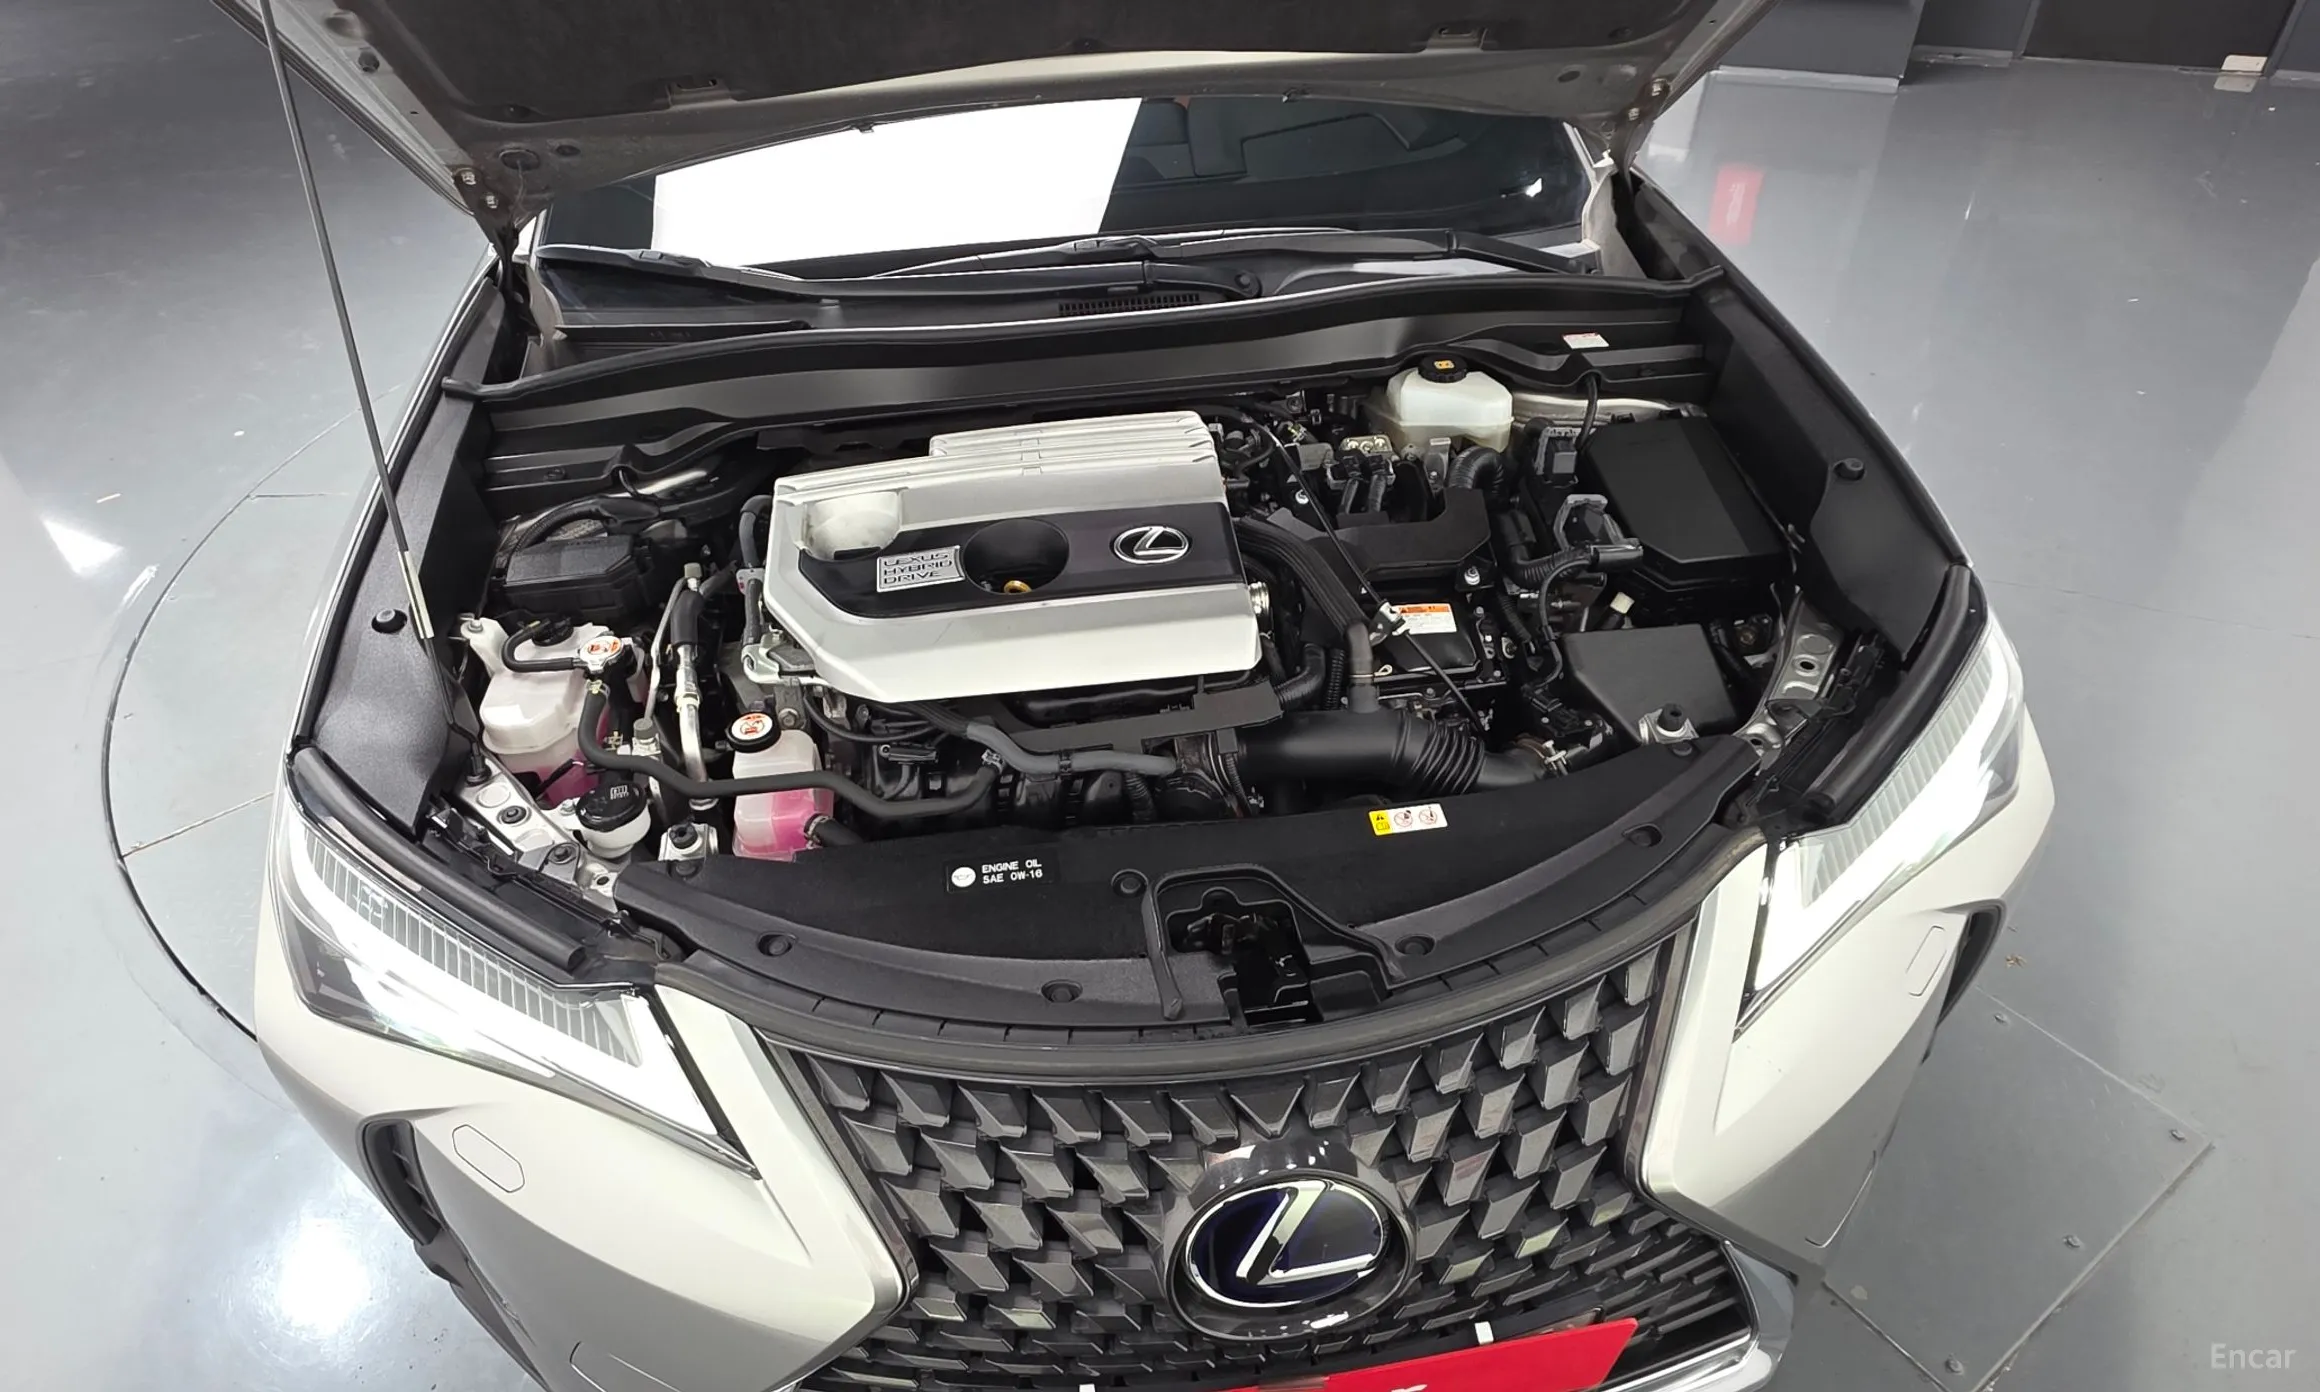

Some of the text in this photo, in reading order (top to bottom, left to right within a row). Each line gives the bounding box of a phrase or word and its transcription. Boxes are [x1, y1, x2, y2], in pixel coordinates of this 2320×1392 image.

[884, 553, 948, 566] LEXUS
[884, 560, 952, 576] HYBRID
[884, 571, 942, 584] DRIVE
[982, 859, 1042, 873] ENGINE OIL
[983, 873, 1004, 884] SAE
